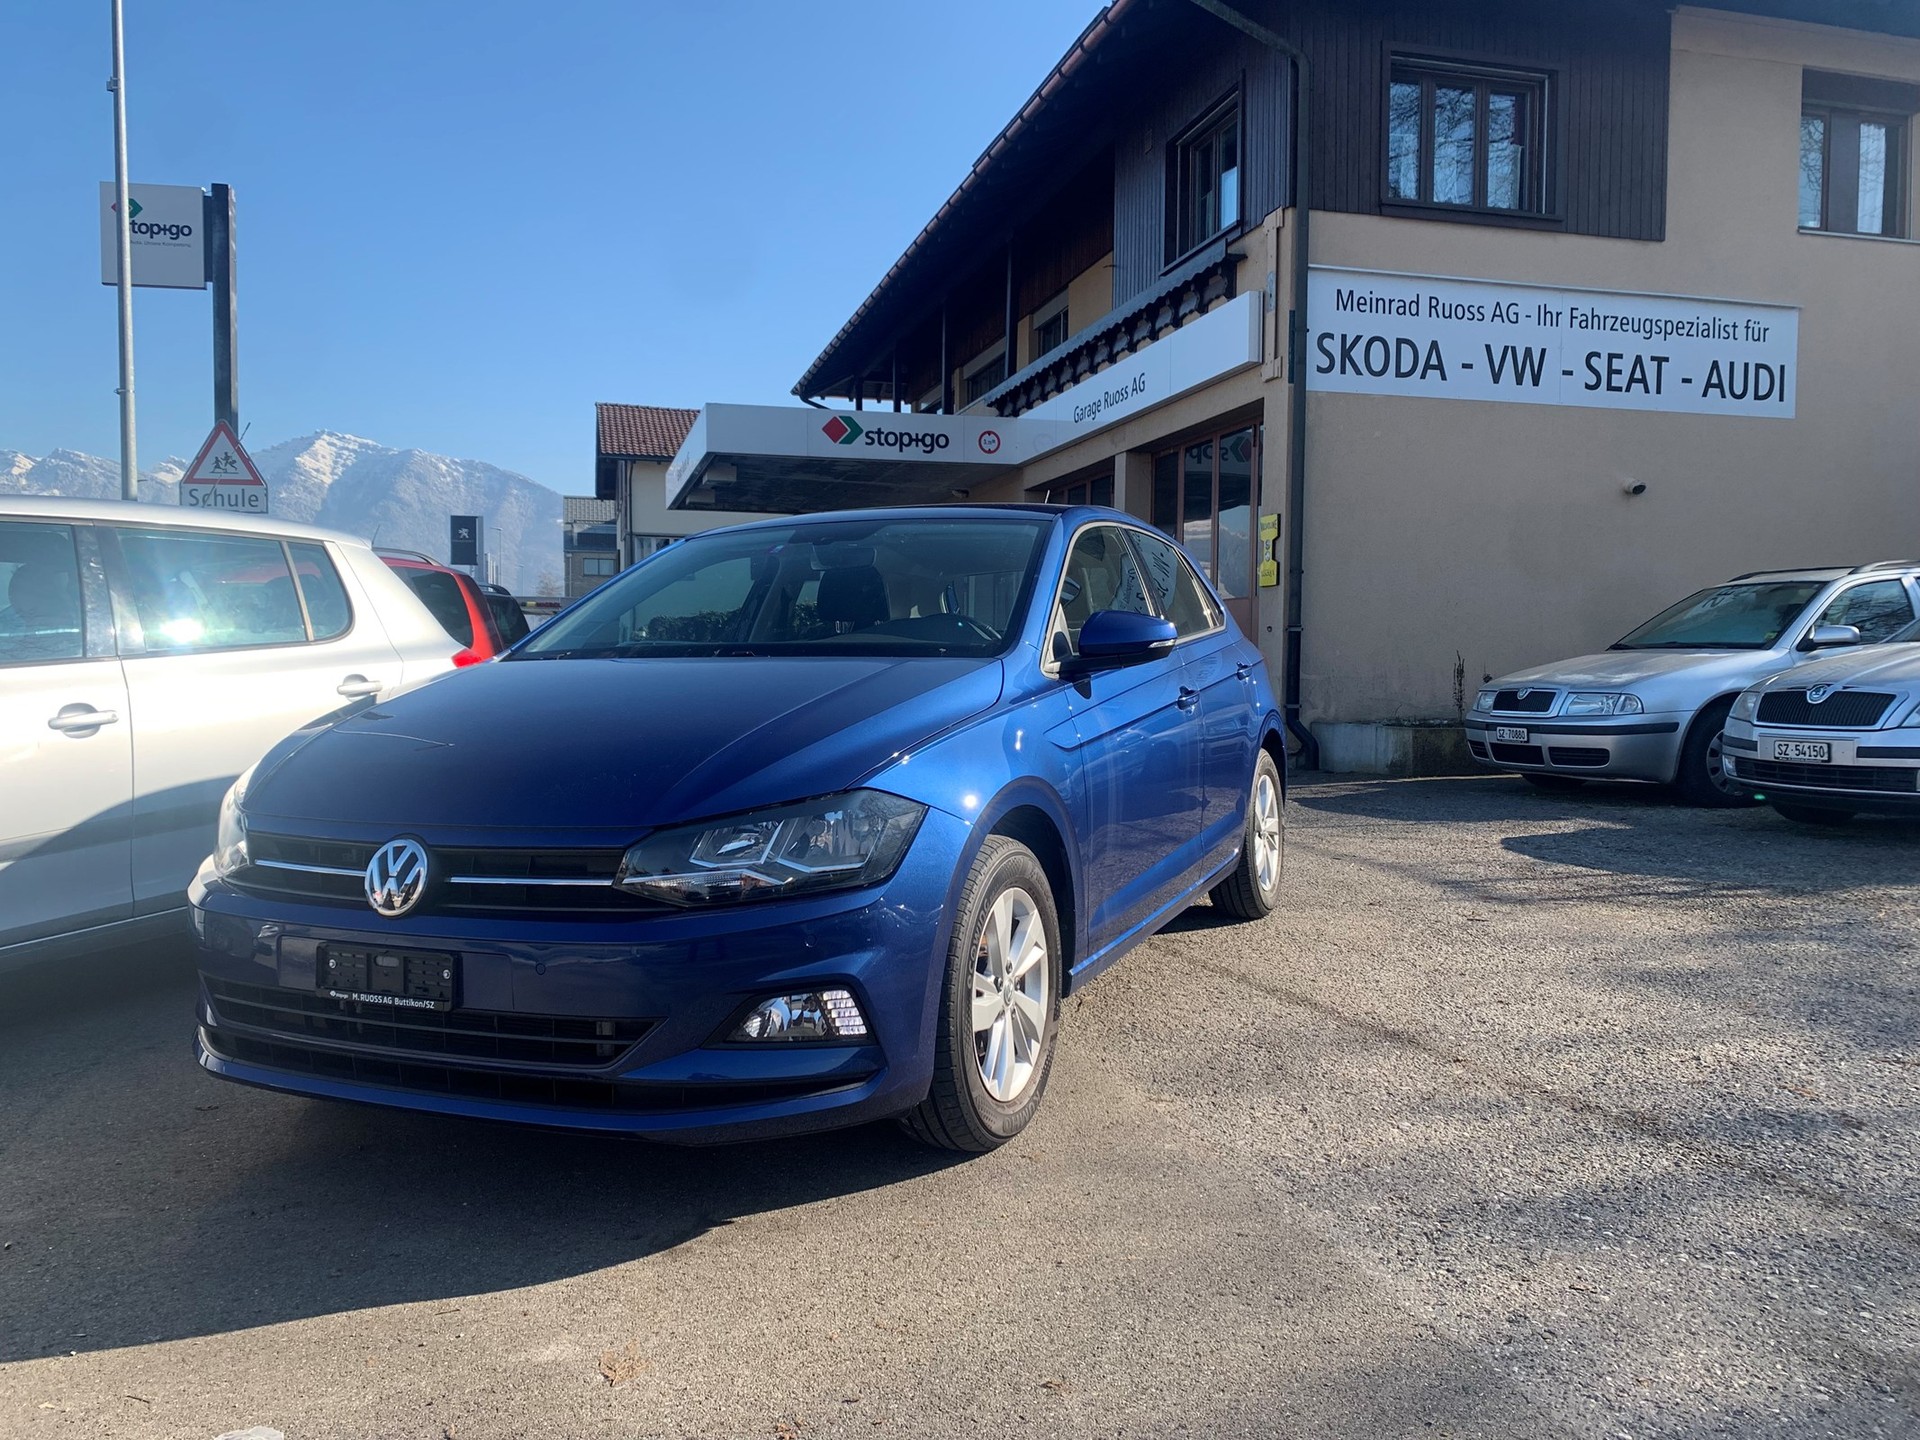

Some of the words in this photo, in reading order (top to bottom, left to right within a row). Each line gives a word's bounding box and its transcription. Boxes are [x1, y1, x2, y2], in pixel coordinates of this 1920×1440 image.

[1335, 288, 1421, 318] Meinrad
[1428, 297, 1485, 323] Ruoss
[1490, 302, 1520, 325] AG
[1537, 304, 1562, 328] Ihr
[1570, 307, 1739, 342] Fahrzeugspezialist
[1745, 319, 1770, 344] für
[1316, 331, 1448, 382] SKODA
[1485, 344, 1547, 387] VW
[1584, 351, 1669, 396] SEAT
[1702, 360, 1786, 403] AUDI
[1074, 399, 1102, 423] Garage
[1104, 386, 1128, 409] Ruoss
[1131, 372, 1145, 397] AG
[865, 427, 950, 454] stop+go
[188, 488, 259, 507] Schule
